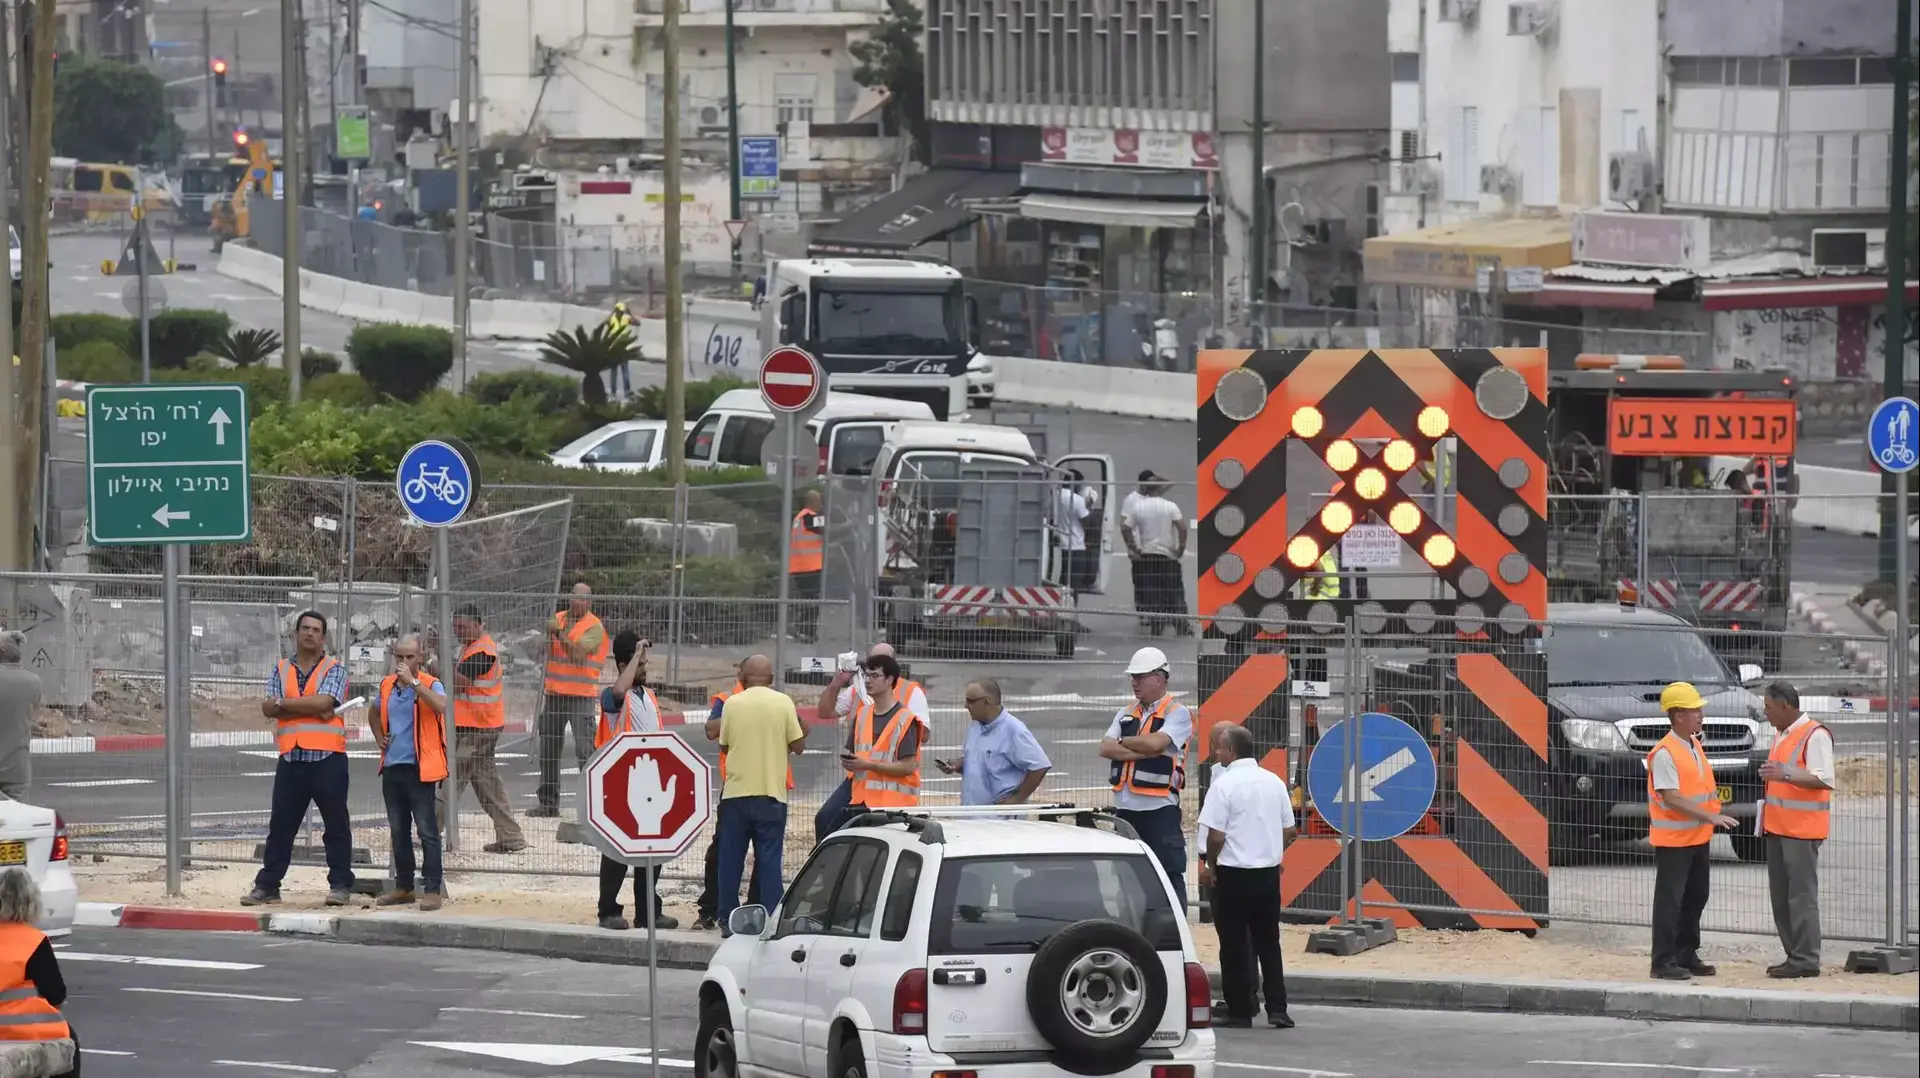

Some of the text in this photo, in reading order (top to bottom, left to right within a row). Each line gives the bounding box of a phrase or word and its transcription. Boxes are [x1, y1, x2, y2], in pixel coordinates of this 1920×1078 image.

[101, 402, 155, 421] הרצל
[141, 431, 167, 446] יפו
[1617, 414, 1788, 444] קבוצת צבע
[108, 474, 229, 497] נתיבי איילון
